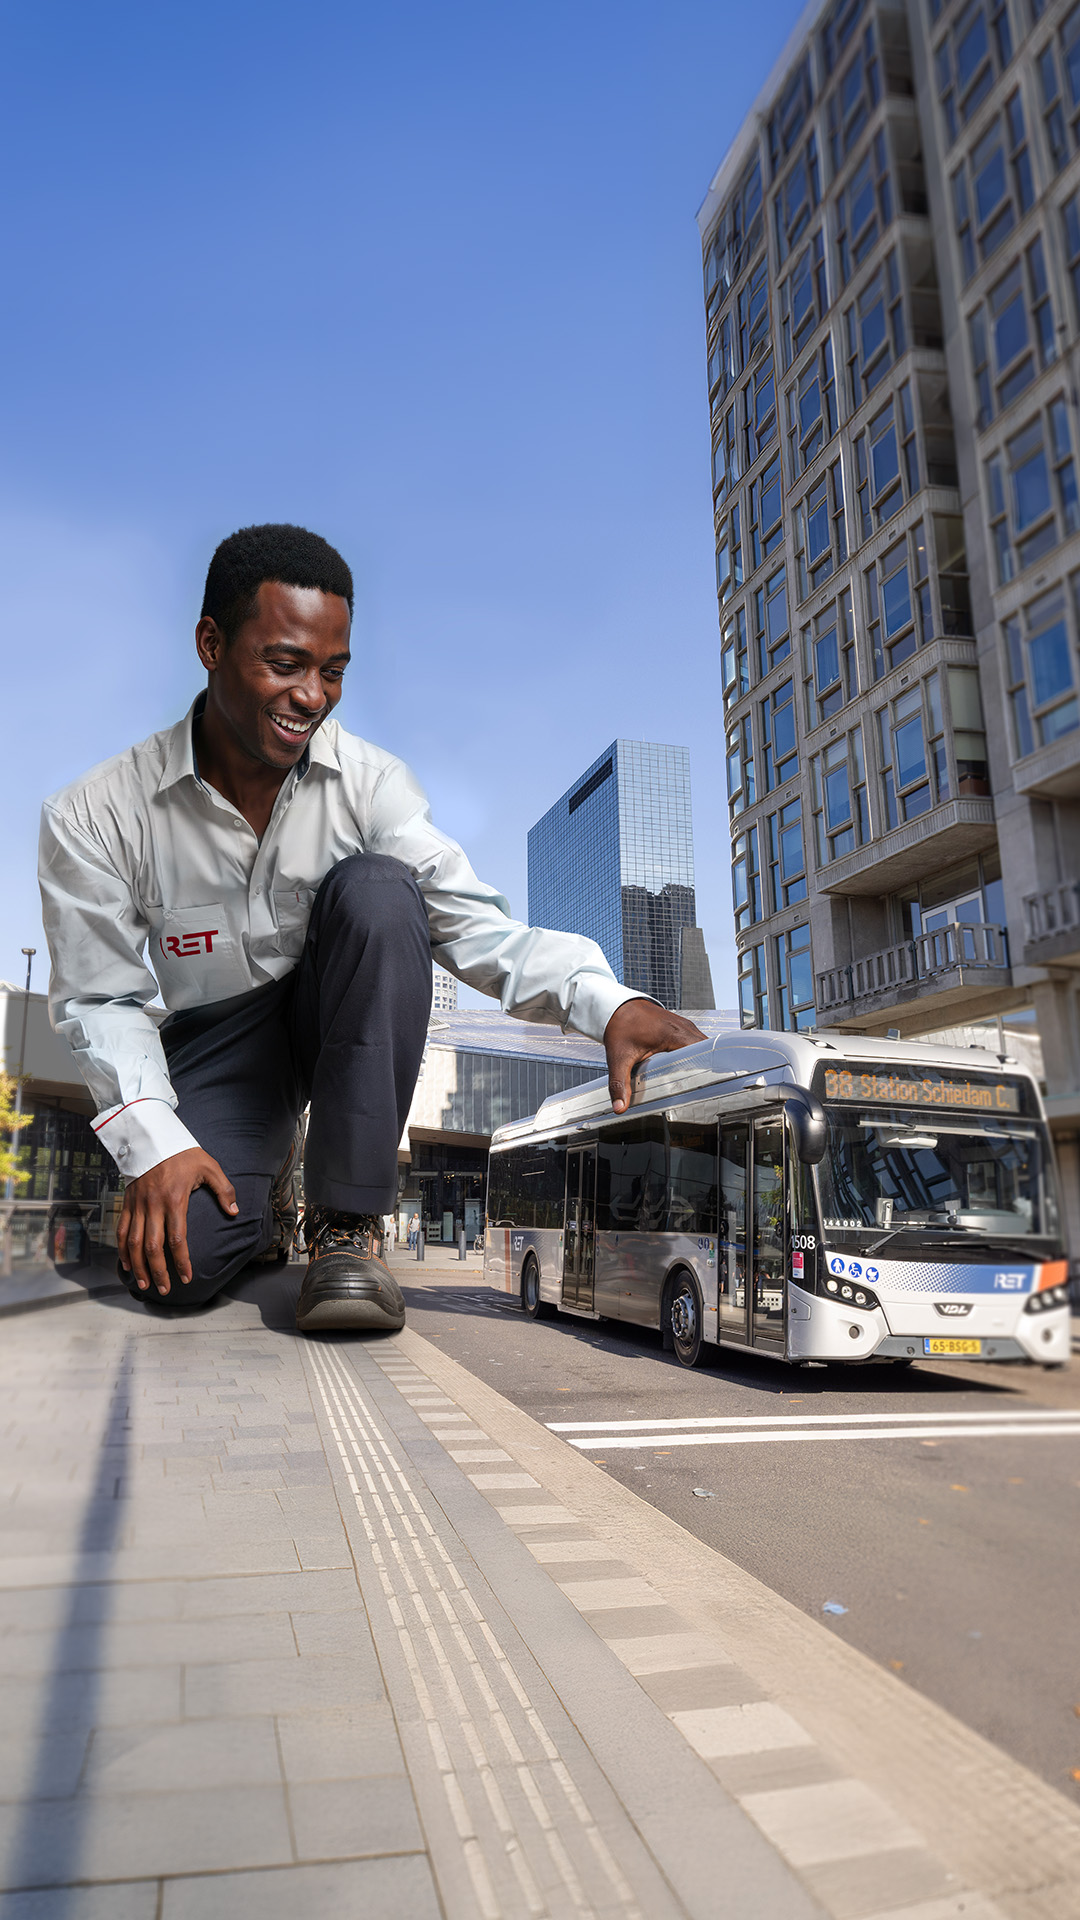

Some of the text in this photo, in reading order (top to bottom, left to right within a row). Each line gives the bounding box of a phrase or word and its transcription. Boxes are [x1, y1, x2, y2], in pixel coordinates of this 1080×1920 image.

[160, 930, 219, 960] RET
[825, 1069, 1011, 1108] 38 Station Schiedam C.
[993, 1273, 1027, 1289] RET
[939, 1304, 969, 1314] VDL
[932, 1341, 977, 1352] 65-BSG-5
